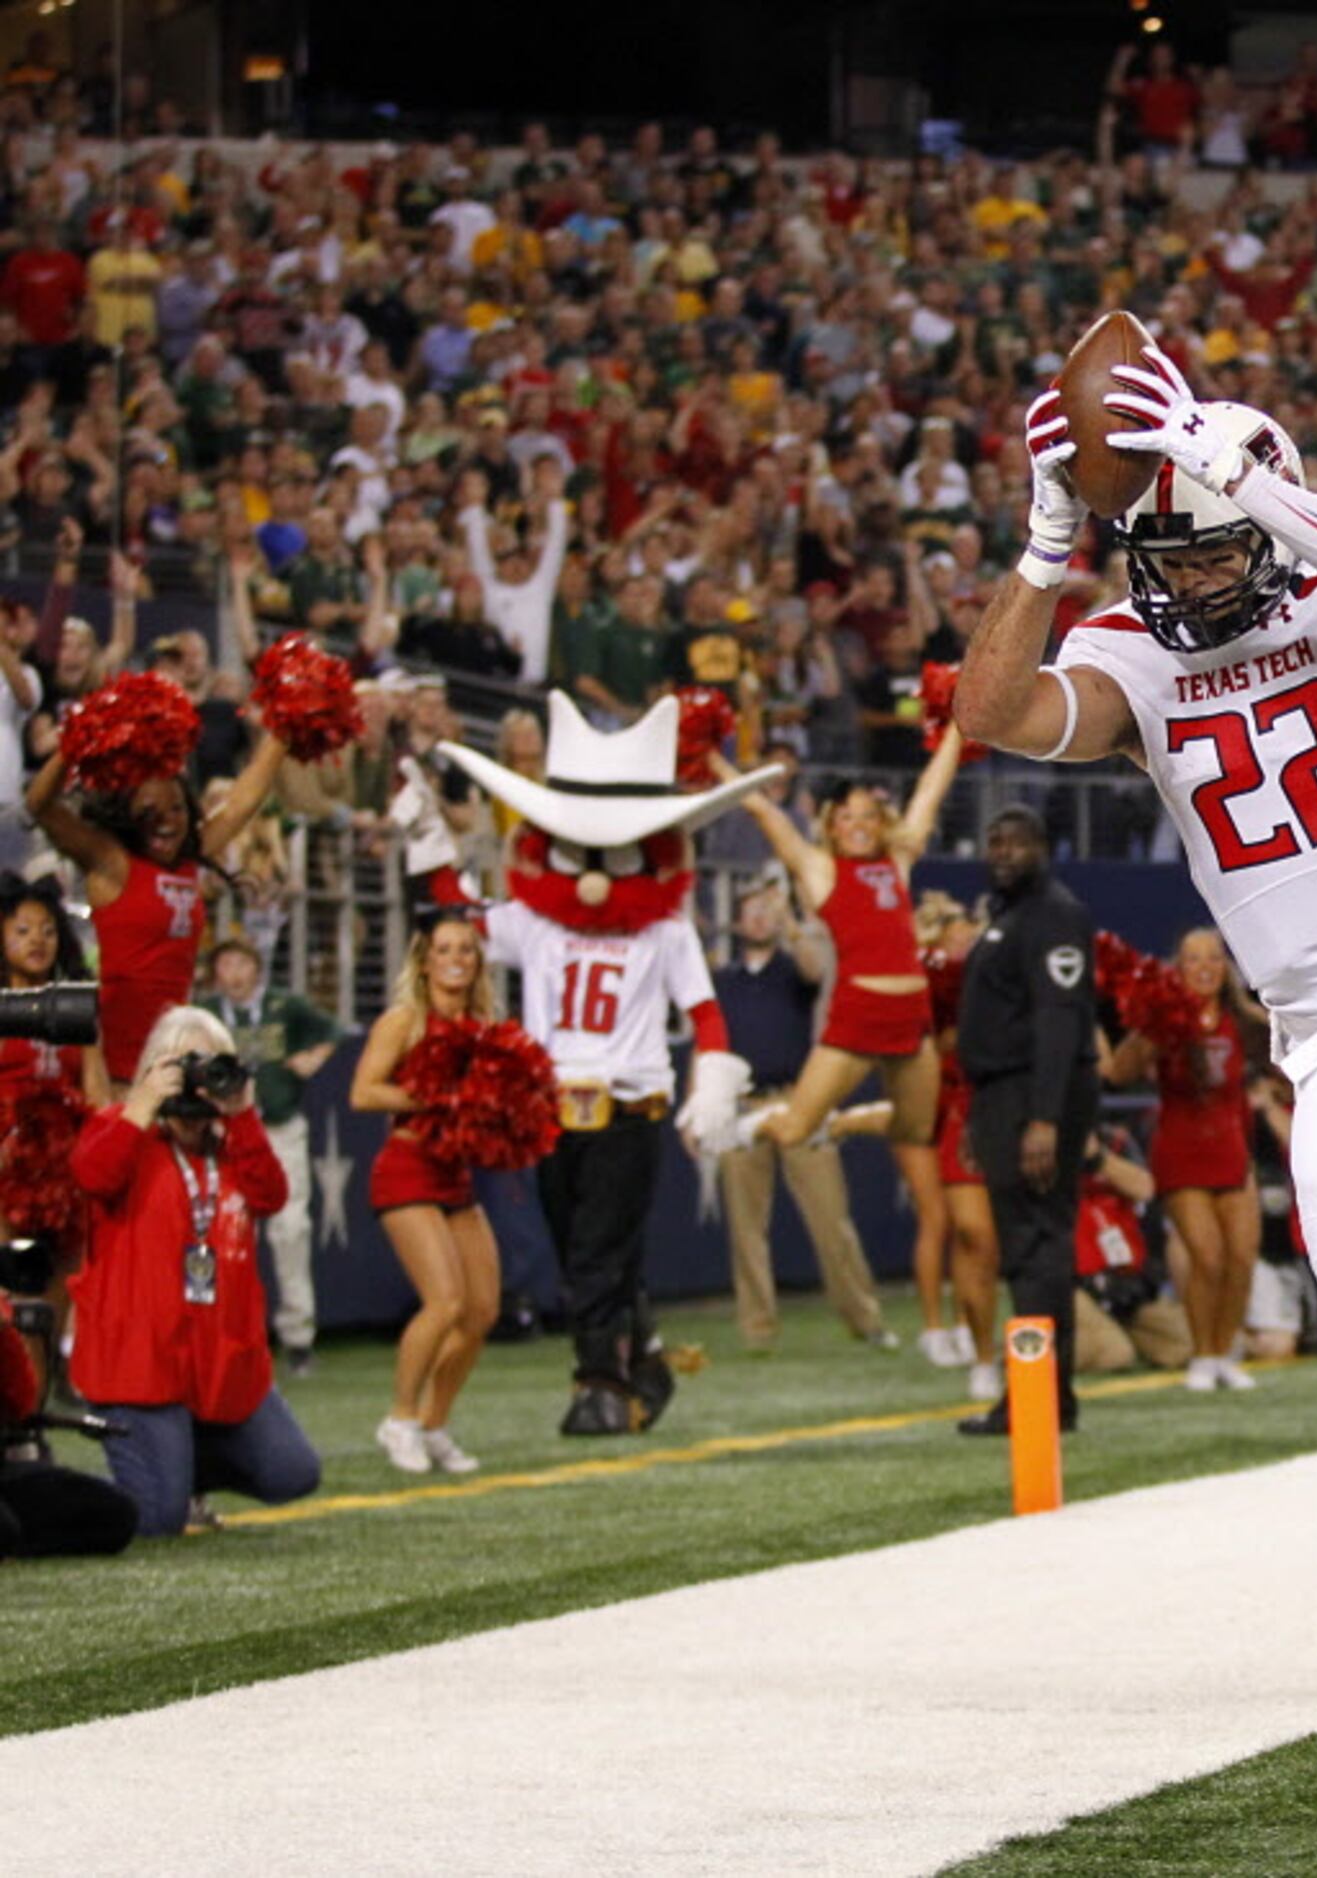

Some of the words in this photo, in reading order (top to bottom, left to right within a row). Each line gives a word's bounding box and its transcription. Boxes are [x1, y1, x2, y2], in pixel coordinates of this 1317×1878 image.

[1174, 662, 1250, 703] TEXAS
[1253, 636, 1315, 684] TECH
[553, 960, 626, 1036] 16
